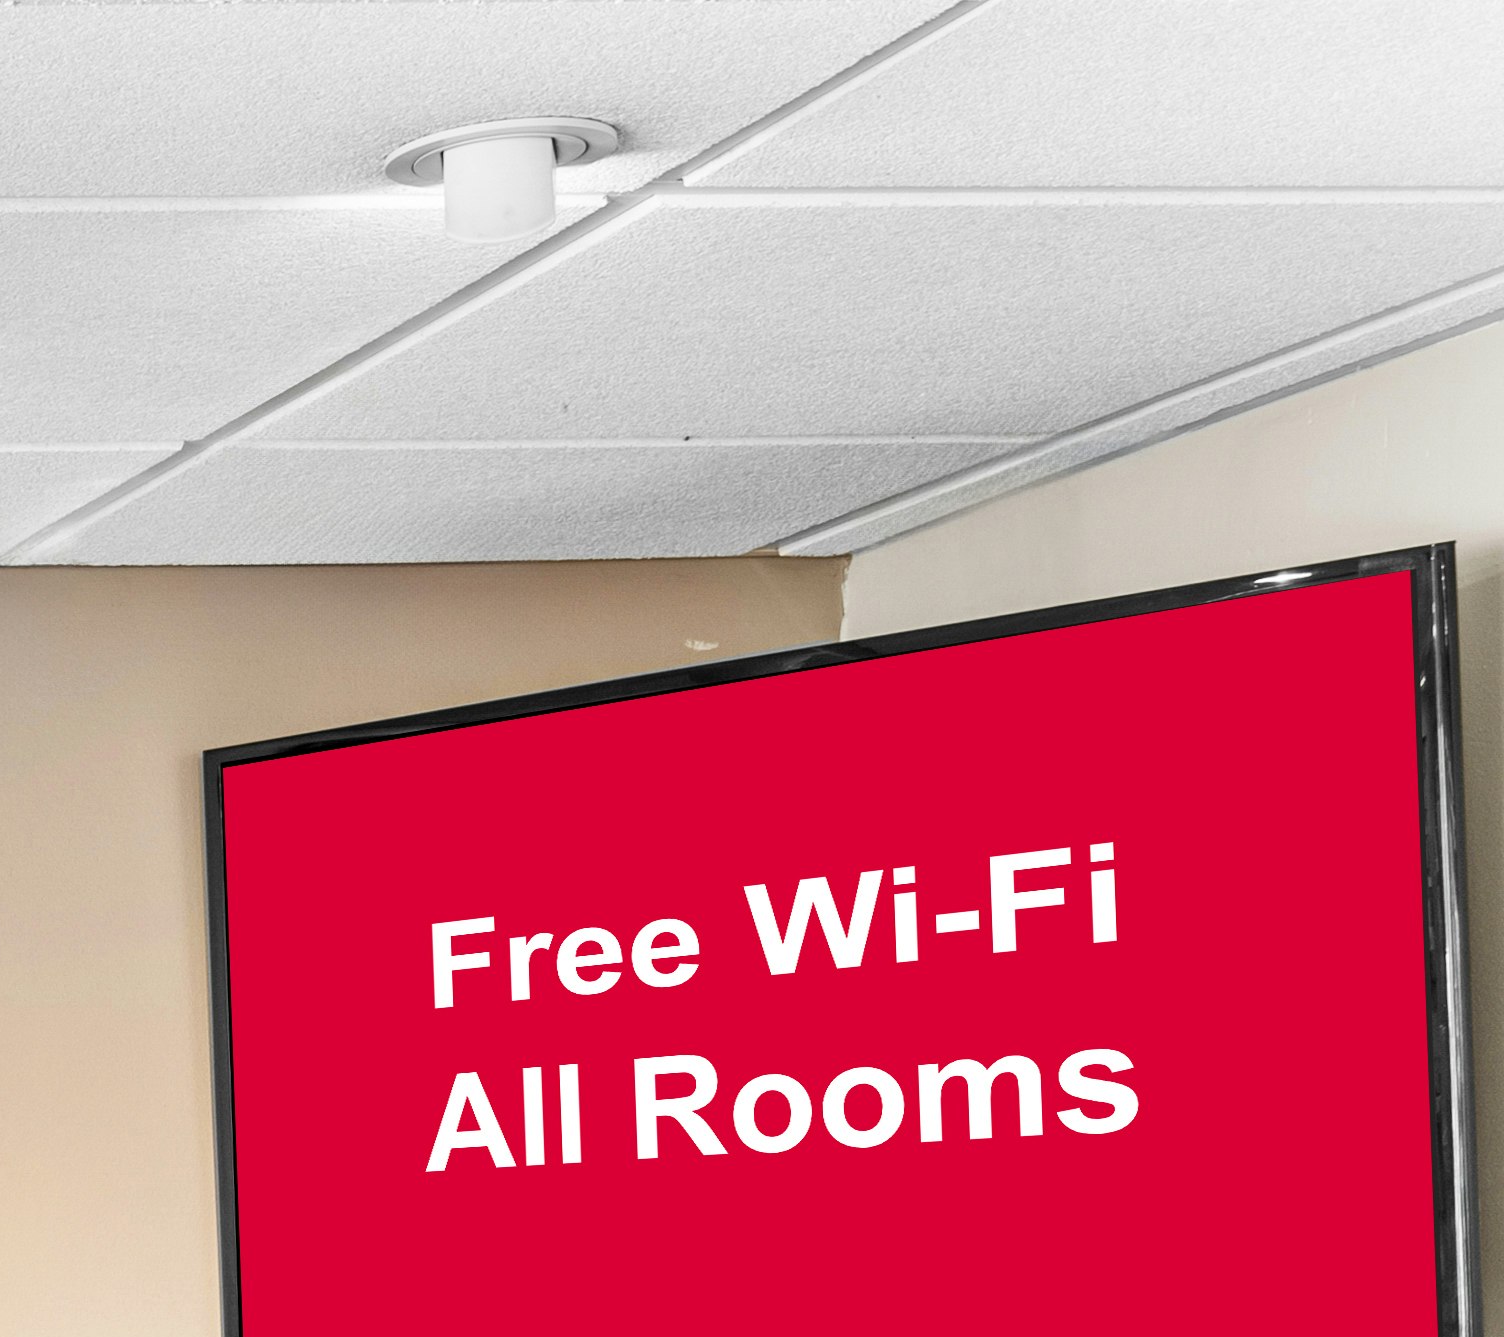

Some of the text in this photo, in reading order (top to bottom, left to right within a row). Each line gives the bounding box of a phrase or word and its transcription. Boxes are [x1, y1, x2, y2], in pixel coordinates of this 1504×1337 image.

[431, 842, 1118, 1009] Free Wi-Fi
[425, 1048, 1139, 1173] All Rooms
